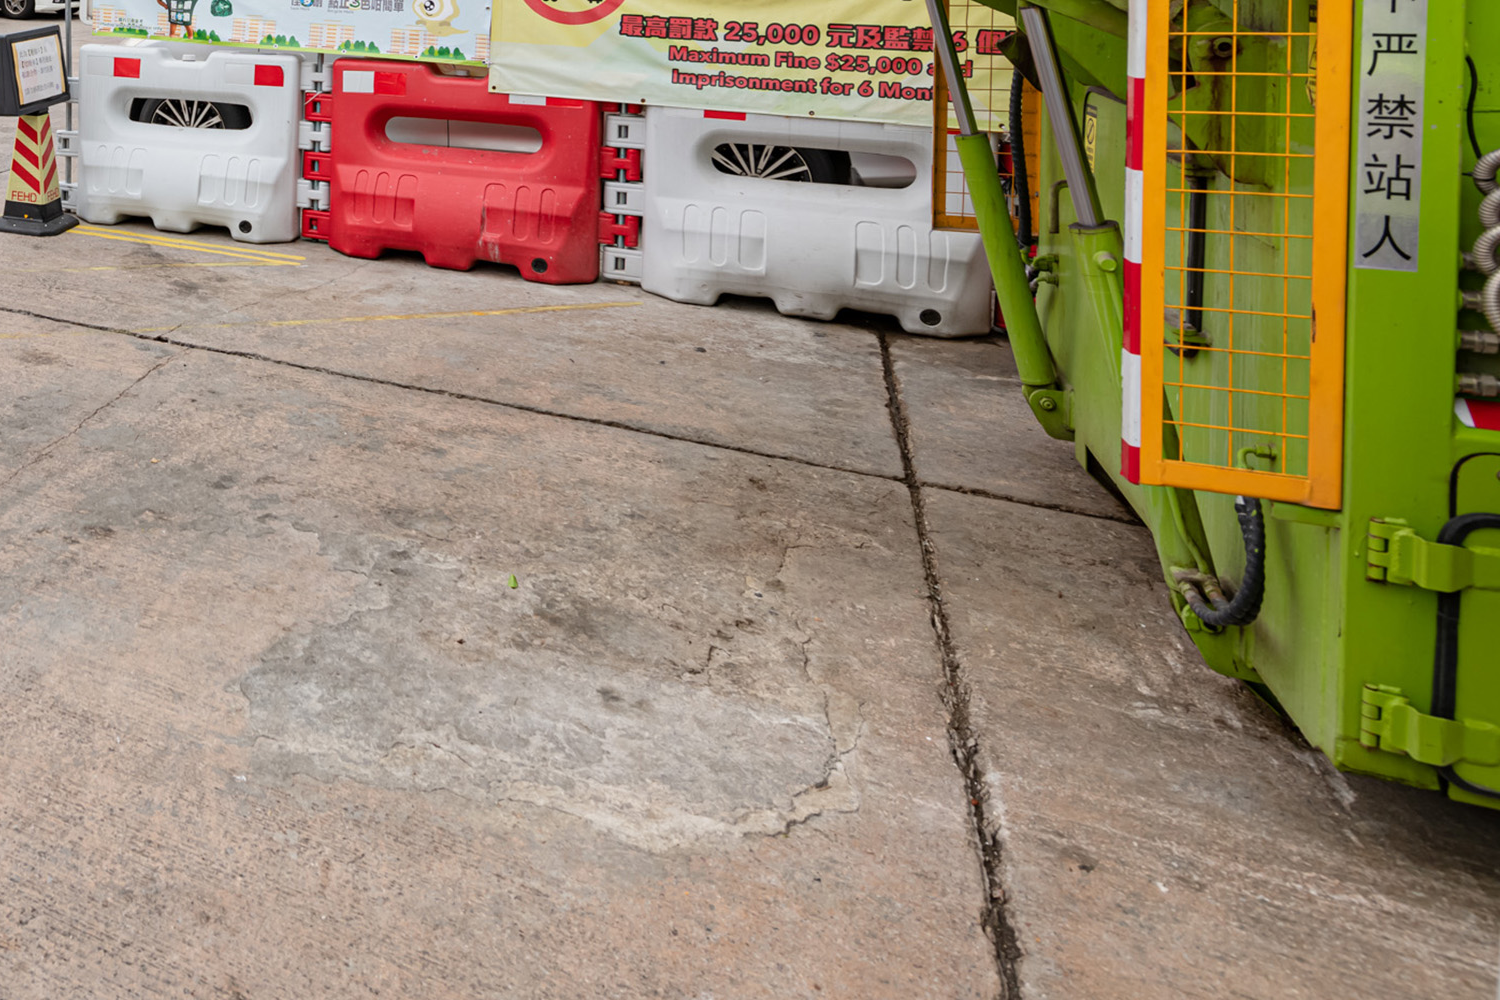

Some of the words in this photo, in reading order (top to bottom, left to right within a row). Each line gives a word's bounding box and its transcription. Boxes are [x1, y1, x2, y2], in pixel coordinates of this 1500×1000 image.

[619, 13, 719, 42] 最高罰款
[724, 22, 821, 47] 25,000
[826, 23, 934, 53] 元及監禁
[668, 44, 770, 70] Maximum
[774, 51, 821, 72] Fine
[825, 53, 923, 75] $25,000
[926, 60, 974, 78] ad
[671, 68, 817, 95] Imprisonment
[820, 77, 854, 97] for
[858, 80, 874, 98] 6
[11, 190, 38, 203] FEHD
